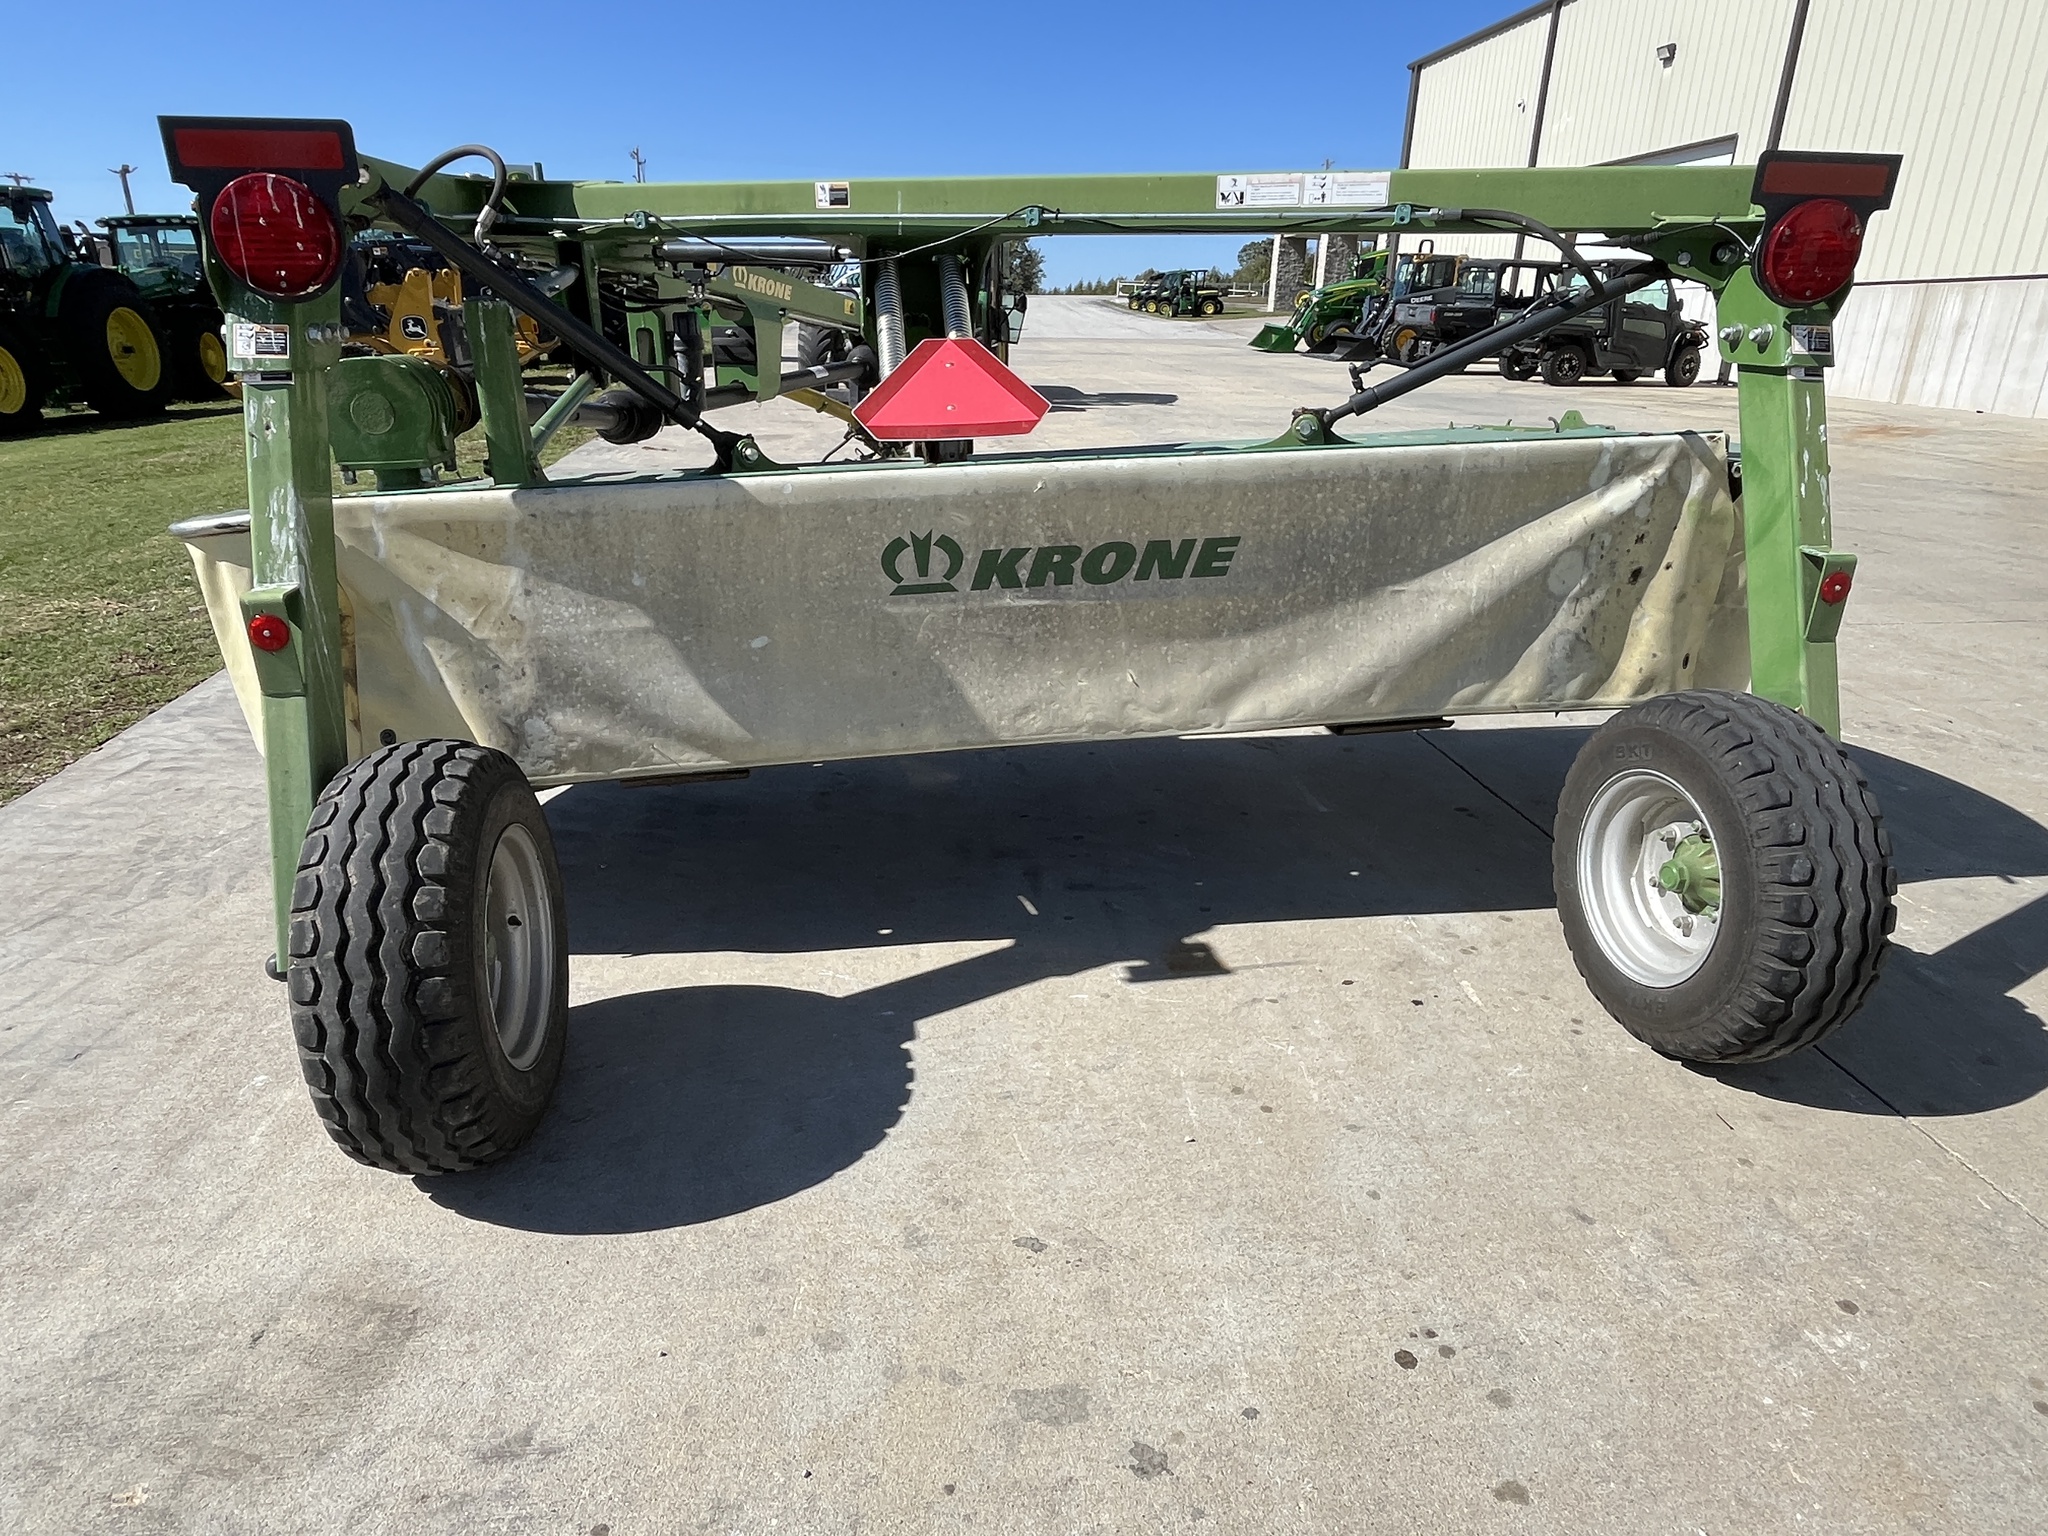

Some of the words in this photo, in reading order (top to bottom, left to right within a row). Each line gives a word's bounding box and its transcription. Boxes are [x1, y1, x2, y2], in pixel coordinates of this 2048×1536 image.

[748, 274, 793, 301] KRONE
[1410, 295, 1433, 304] DEERE
[970, 535, 1242, 592] KRONE
[1615, 742, 1653, 762] BKT
